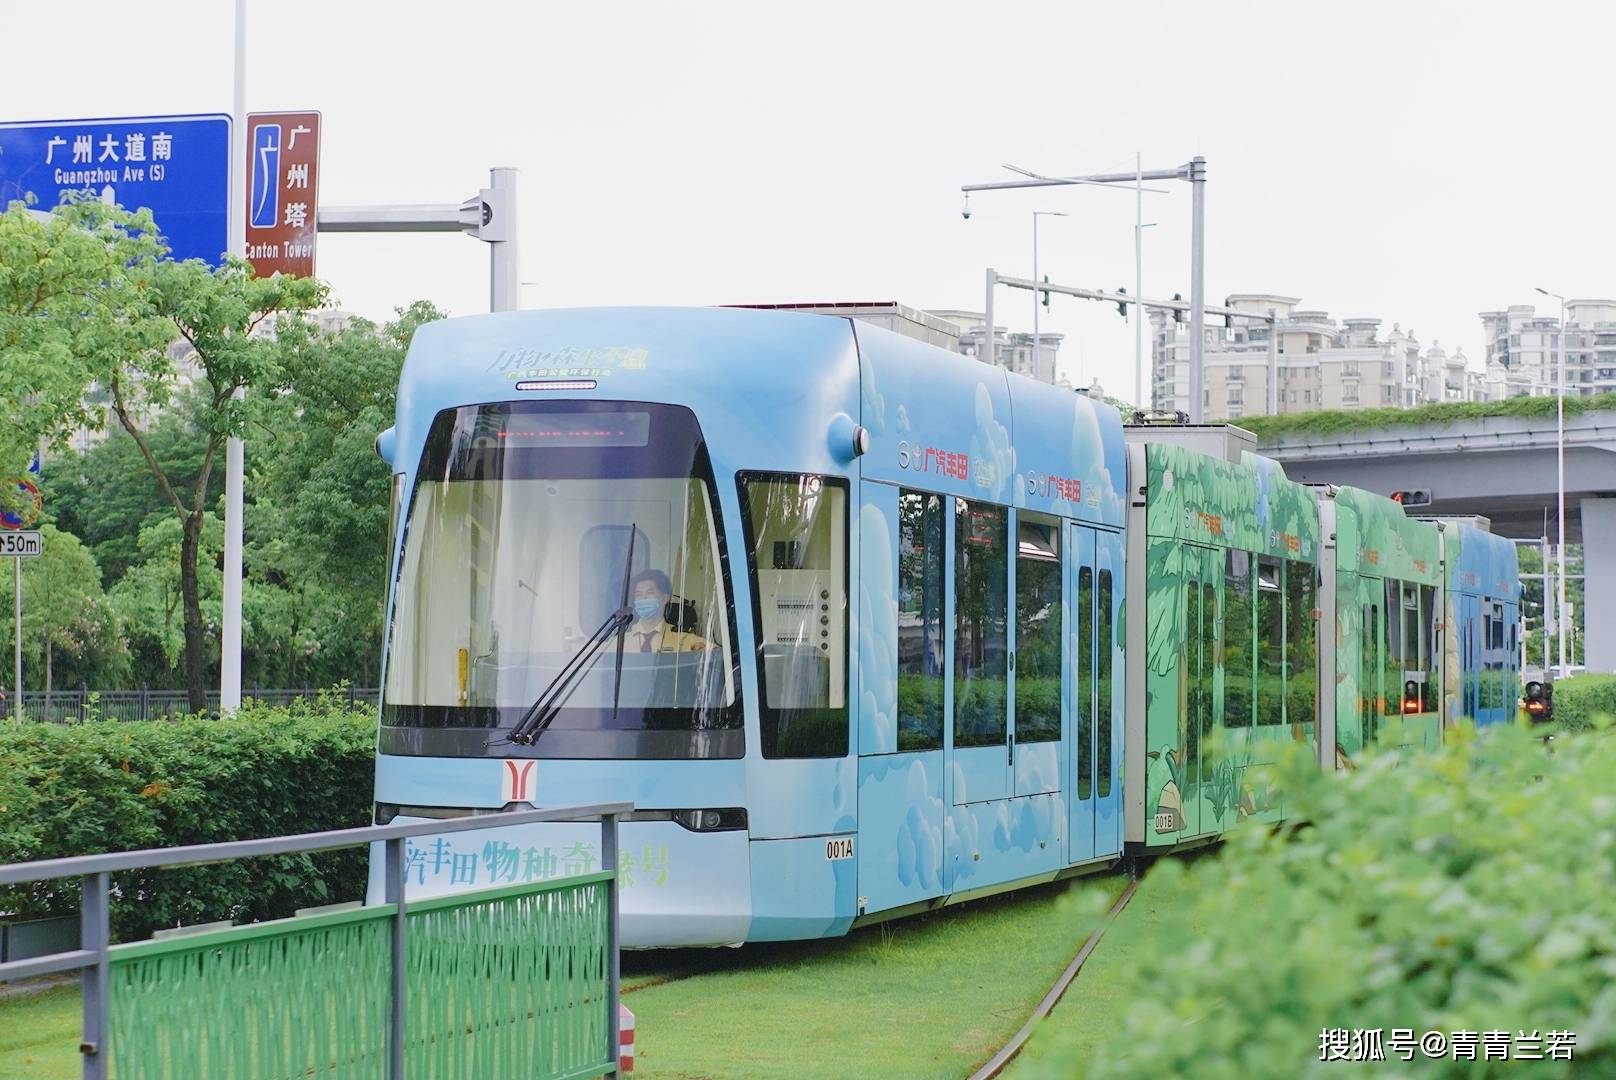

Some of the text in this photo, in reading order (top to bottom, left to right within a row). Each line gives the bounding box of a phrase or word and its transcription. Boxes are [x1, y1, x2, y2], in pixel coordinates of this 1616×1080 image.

[46, 131, 173, 164] 广州大道南
[55, 164, 165, 188] Guangzhou Ave (S)
[284, 124, 311, 228] 广州塔
[245, 241, 312, 259] Canton Tower
[925, 447, 968, 480] 广汽丰田
[1048, 475, 1081, 503] 广汽丰田
[7, 535, 37, 552] 50m
[1156, 815, 1172, 828] 001B
[826, 839, 854, 860] 001A
